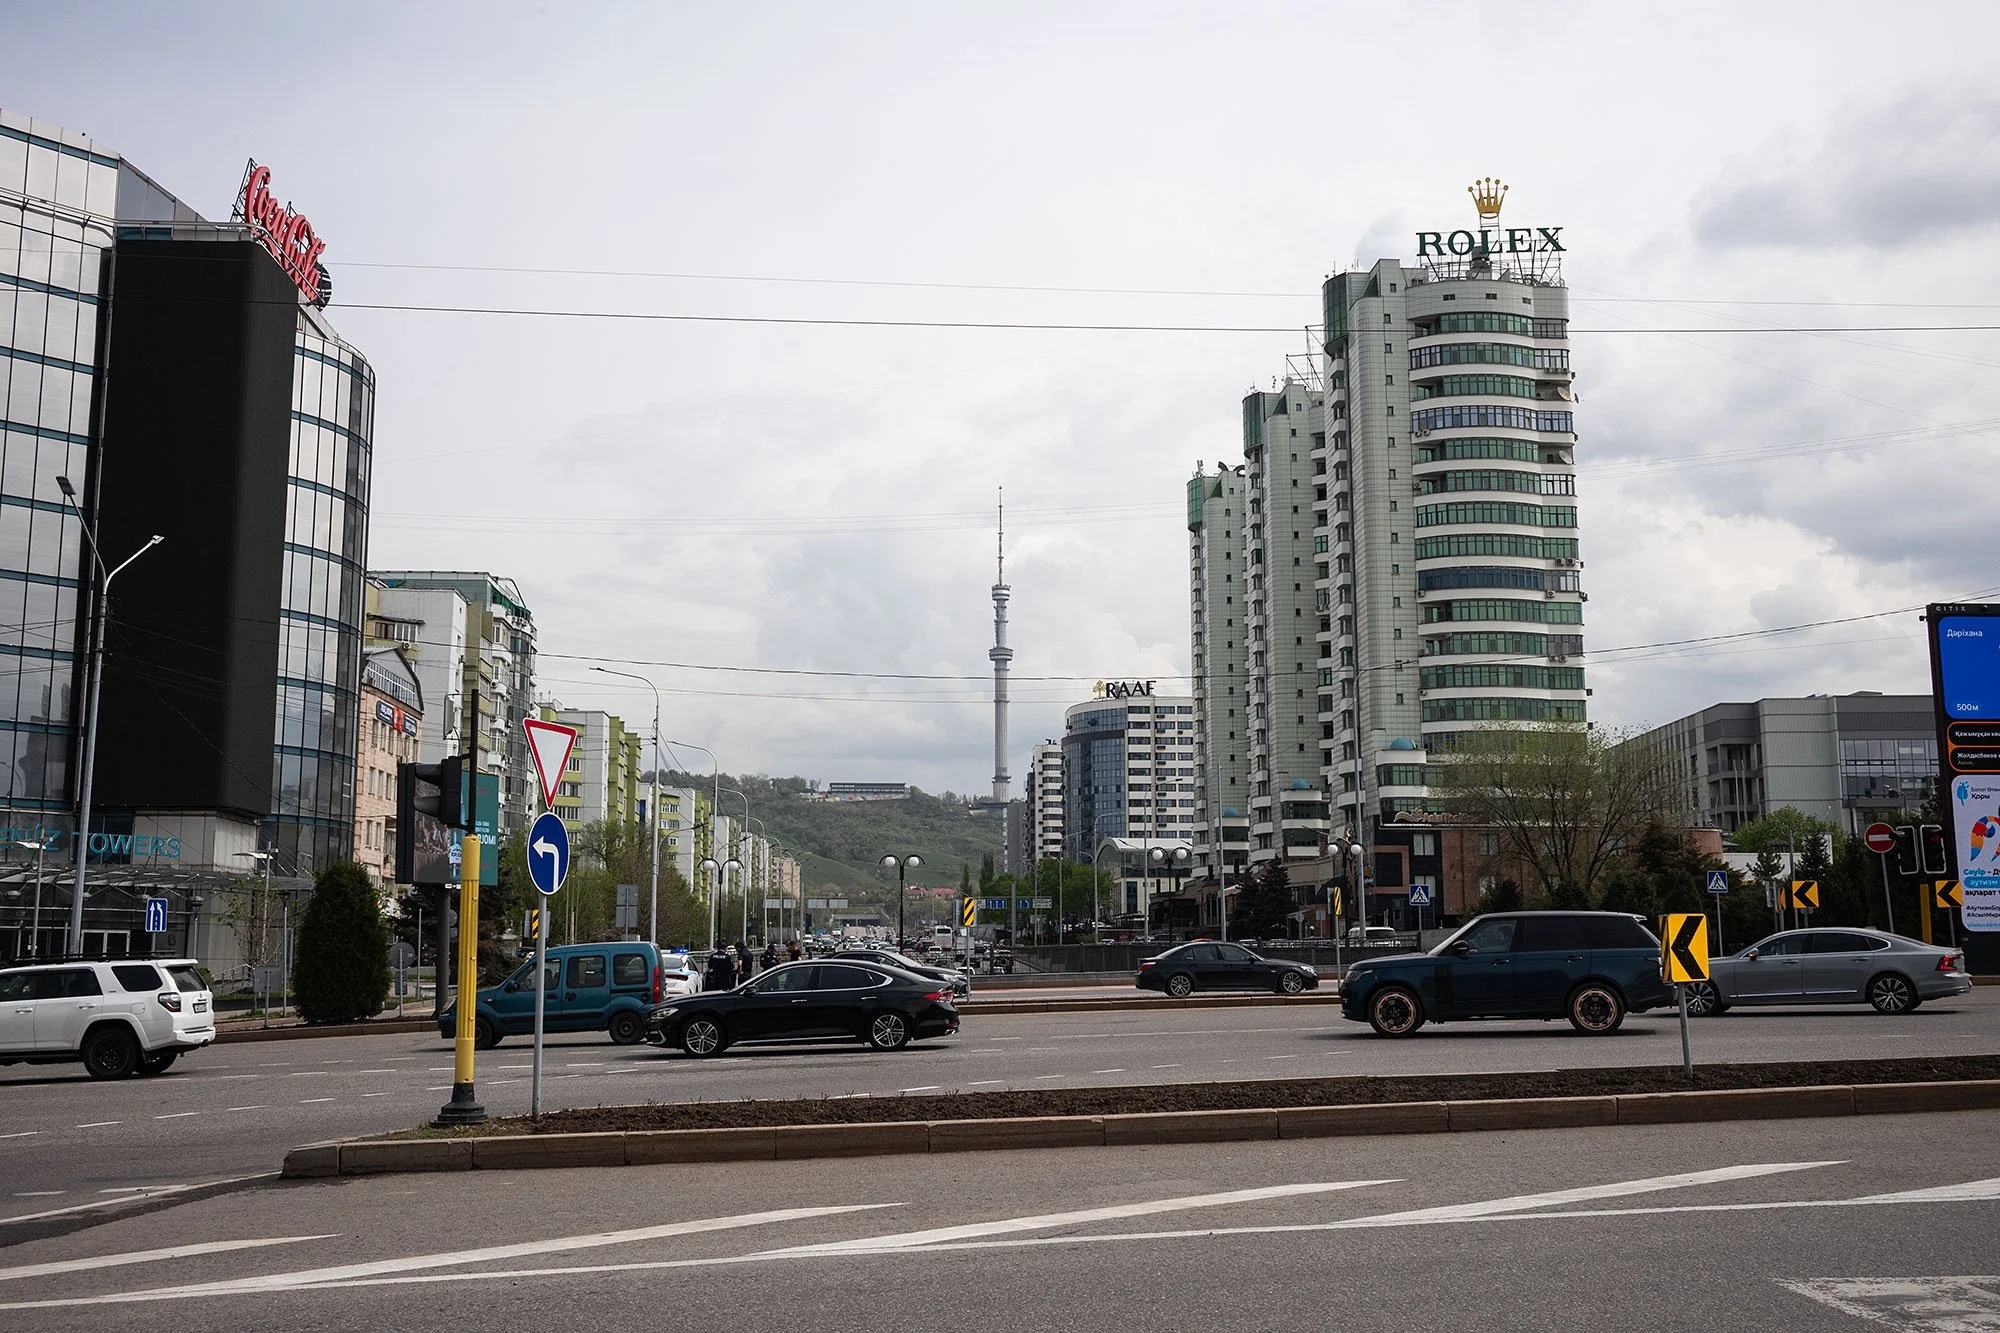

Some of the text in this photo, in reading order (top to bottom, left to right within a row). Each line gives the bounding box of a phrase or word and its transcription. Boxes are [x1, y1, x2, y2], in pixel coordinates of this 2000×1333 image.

[1415, 227, 1567, 257] ROLEX
[1946, 629, 1983, 638] Дәріхана
[1105, 680, 1157, 698] RAAF
